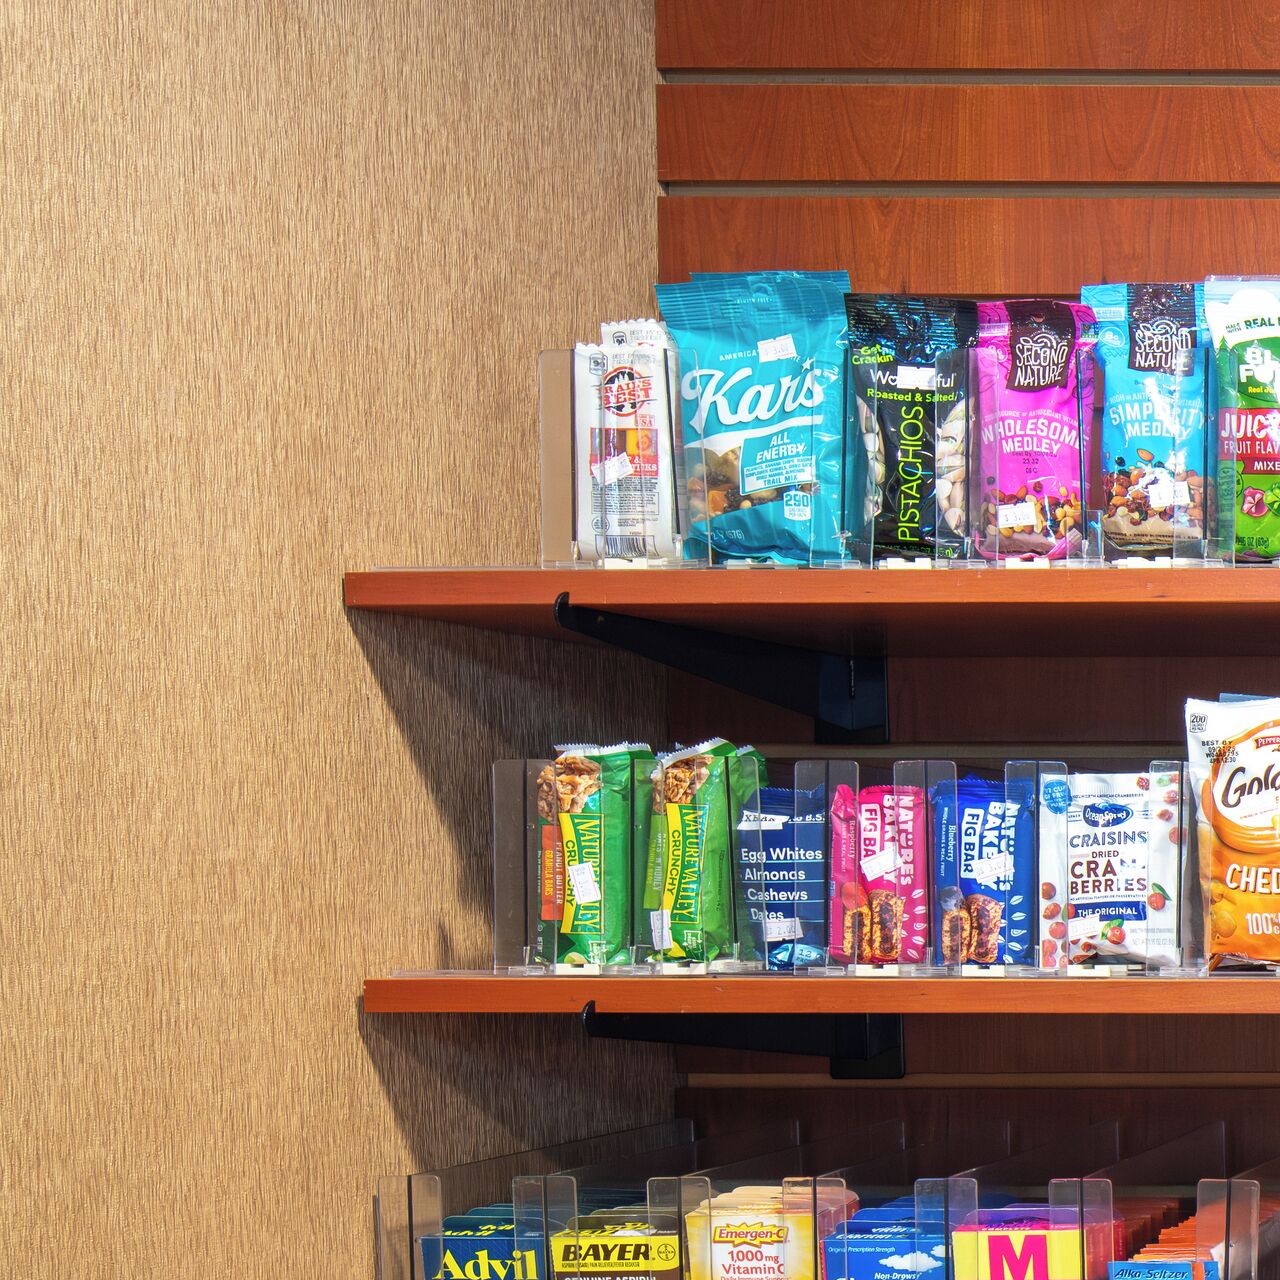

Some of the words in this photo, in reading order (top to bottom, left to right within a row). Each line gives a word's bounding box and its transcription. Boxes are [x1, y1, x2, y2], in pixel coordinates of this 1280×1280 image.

[1015, 344, 1068, 367] SECOND
[1015, 367, 1063, 386] NATURE
[867, 389, 912, 401] Roasted
[914, 393, 922, 401] &
[1221, 413, 1280, 438] JUICY
[770, 432, 791, 446] ALL
[1002, 437, 1061, 454] MEDLEY
[764, 475, 782, 486] TRAIL
[785, 474, 798, 484] MIX
[898, 406, 923, 541] PISTACHIOS
[683, 809, 706, 866] NATURE
[666, 829, 680, 895] CRUNCHY
[742, 849, 766, 863] Egg
[770, 849, 822, 859] Whites
[1092, 850, 1119, 859] DRIED
[676, 865, 700, 918] VALLEY
[748, 888, 808, 901] Cashews
[1078, 909, 1092, 918] THE
[1096, 907, 1138, 916] ORIGINAL
[719, 1228, 784, 1241] Emergen-C
[562, 1244, 652, 1260] BAYER
[728, 1251, 763, 1263] 1,000
[765, 1255, 779, 1264] mg
[432, 1249, 538, 1280] Advil
[1115, 1269, 1188, 1280] Alka-Seltzer
